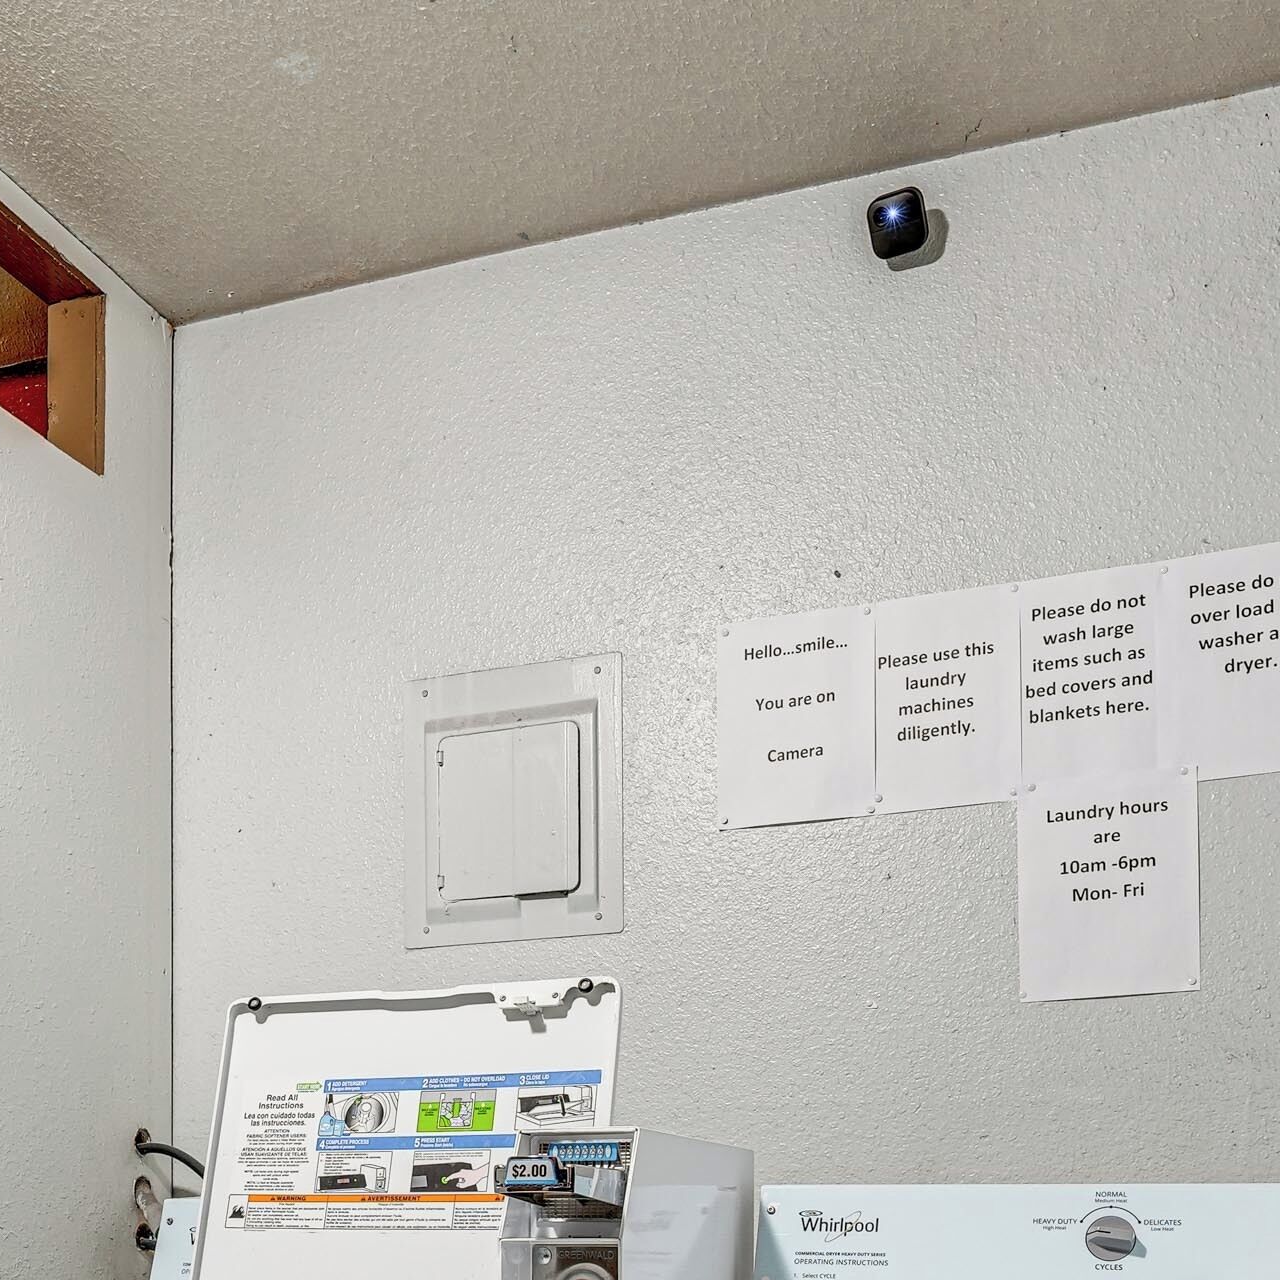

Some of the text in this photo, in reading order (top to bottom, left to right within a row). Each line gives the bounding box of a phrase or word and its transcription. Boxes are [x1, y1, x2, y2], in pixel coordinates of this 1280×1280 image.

[1189, 581, 1246, 599] Please
[1251, 574, 1274, 590] do
[1031, 594, 1146, 622] Please do not
[1190, 609, 1231, 625] over
[1236, 598, 1274, 619] load
[1042, 623, 1134, 646] wash large
[1198, 631, 1264, 650] washer
[878, 641, 994, 670] Please use this
[1032, 647, 1146, 673] items such as
[1224, 656, 1278, 675] dryer.
[905, 671, 966, 691] laundry
[1025, 669, 1153, 699] bed covers and
[755, 691, 835, 711] You are on
[899, 697, 974, 717] machines
[1029, 700, 1149, 724] blankets here.
[897, 719, 976, 742] diligently.
[767, 746, 824, 763] Camera
[1046, 801, 1169, 824] Laundry hours
[1093, 831, 1121, 844] are
[1060, 855, 1156, 875] 10am -6pm
[1072, 881, 1144, 902] Mon- Fri
[327, 1081, 331, 1091] 1
[422, 1079, 429, 1088] 2
[519, 1075, 526, 1085] 3
[320, 1140, 325, 1149] 4
[414, 1138, 420, 1147] 5
[511, 1164, 547, 1179] $2.00
[800, 1217, 879, 1237] Whirlpool
